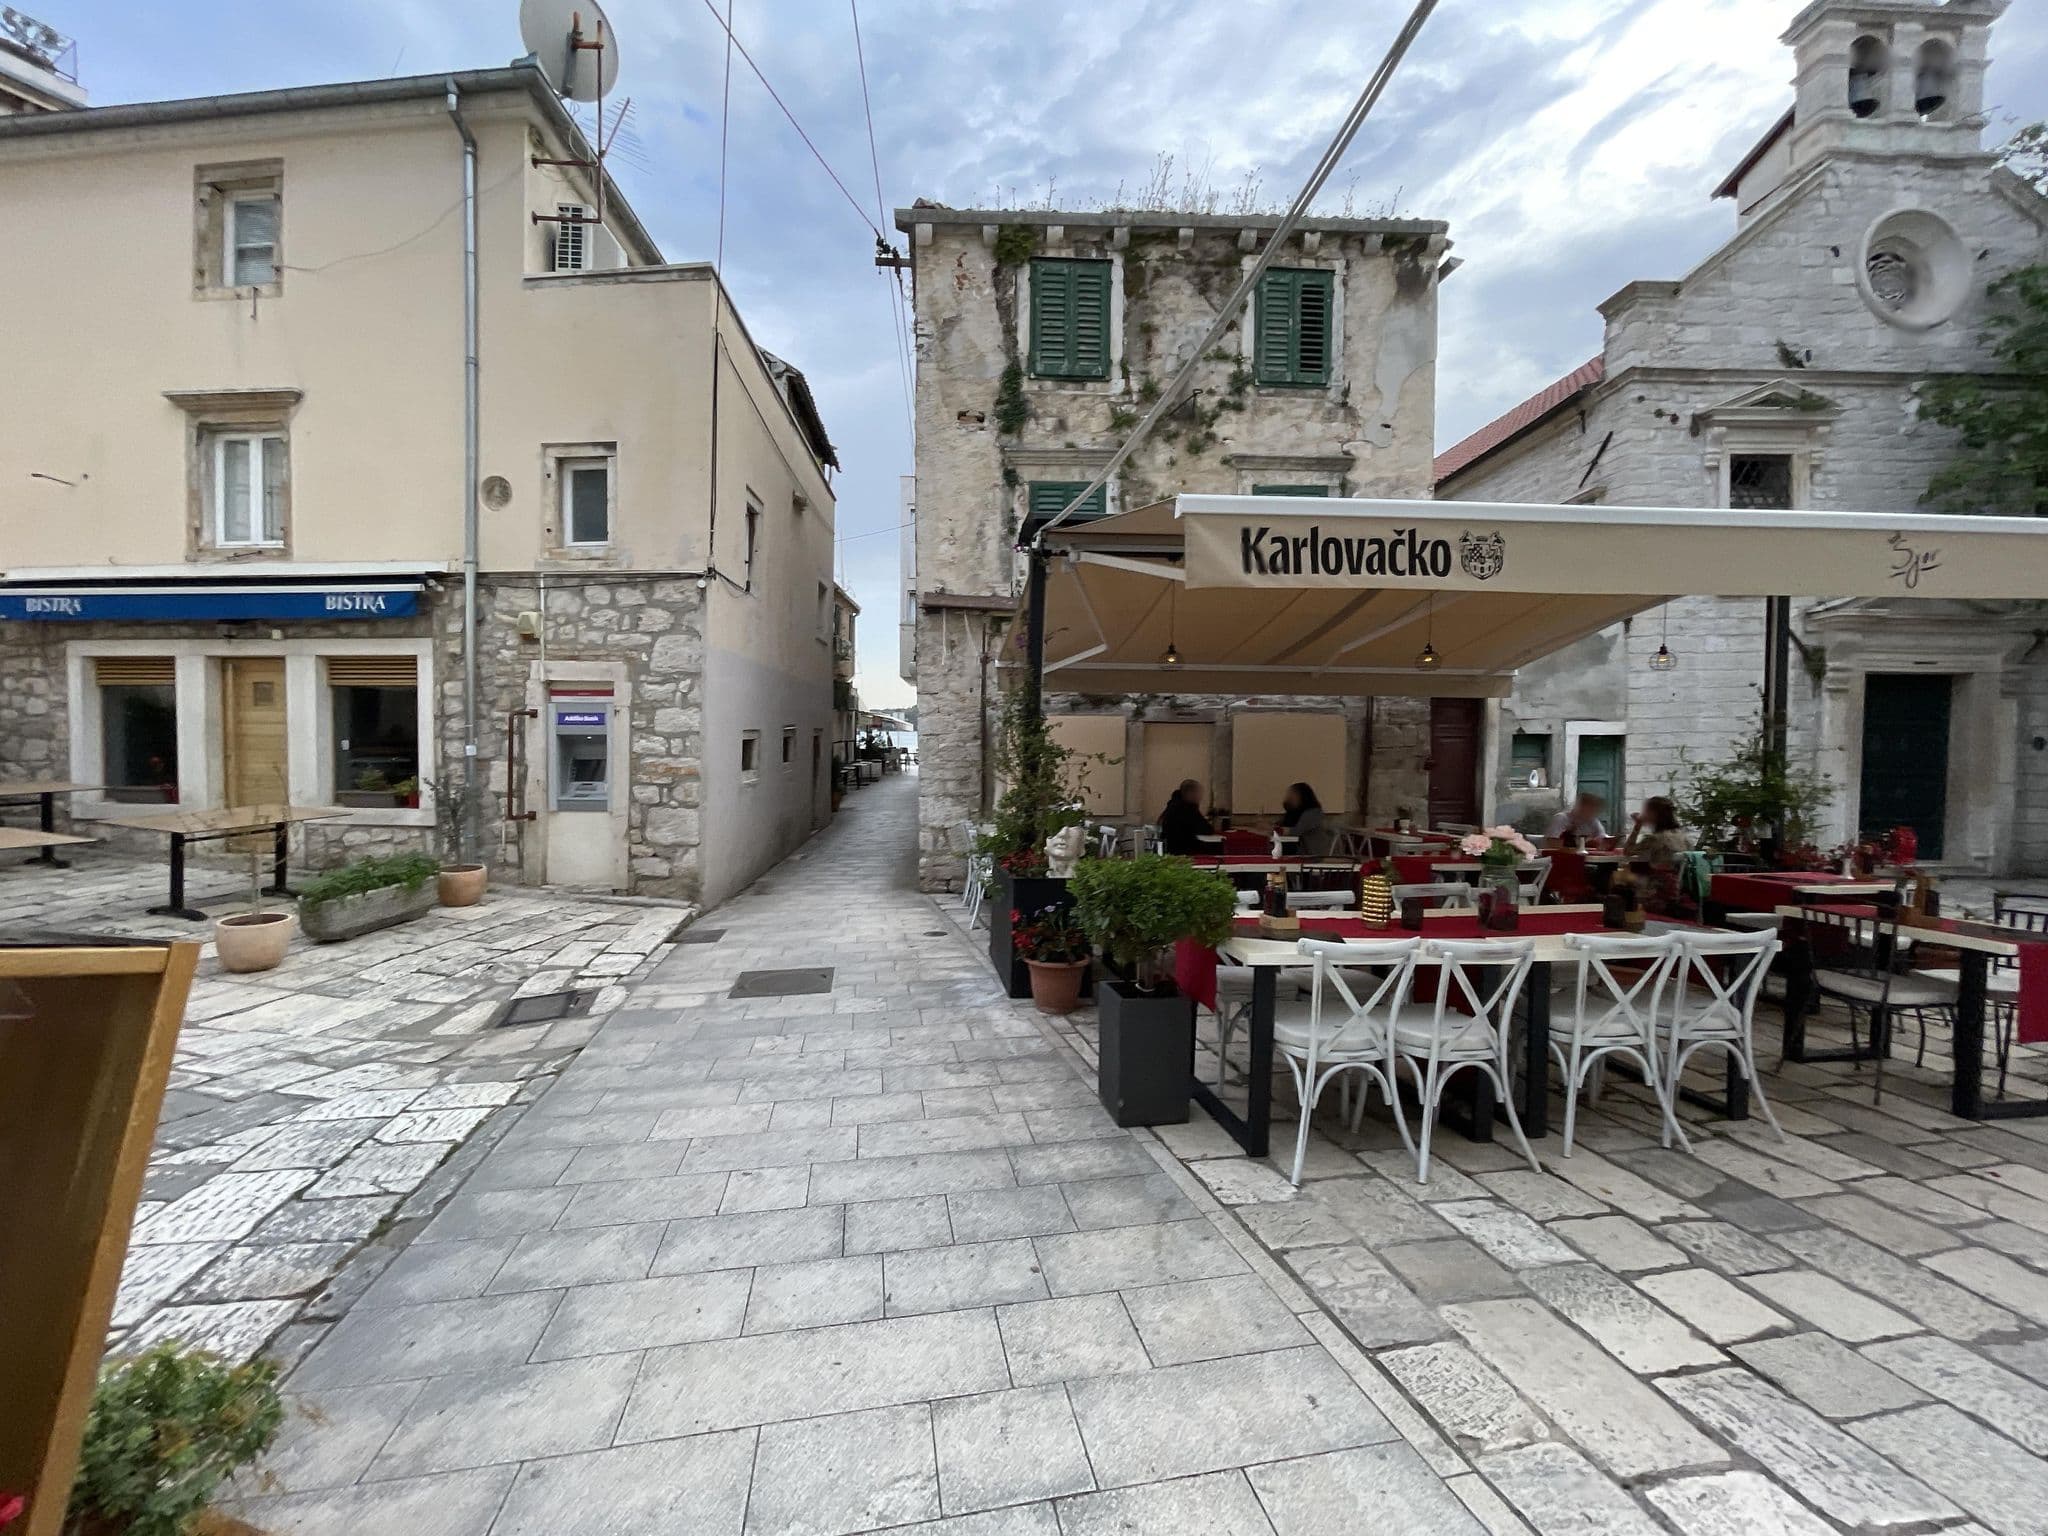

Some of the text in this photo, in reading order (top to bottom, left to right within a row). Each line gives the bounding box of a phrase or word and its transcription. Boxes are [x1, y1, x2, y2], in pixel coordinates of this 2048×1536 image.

[1241, 526, 1451, 577] Karlovačko
[26, 598, 82, 615] BISTRA
[326, 595, 386, 613] BISTRA
